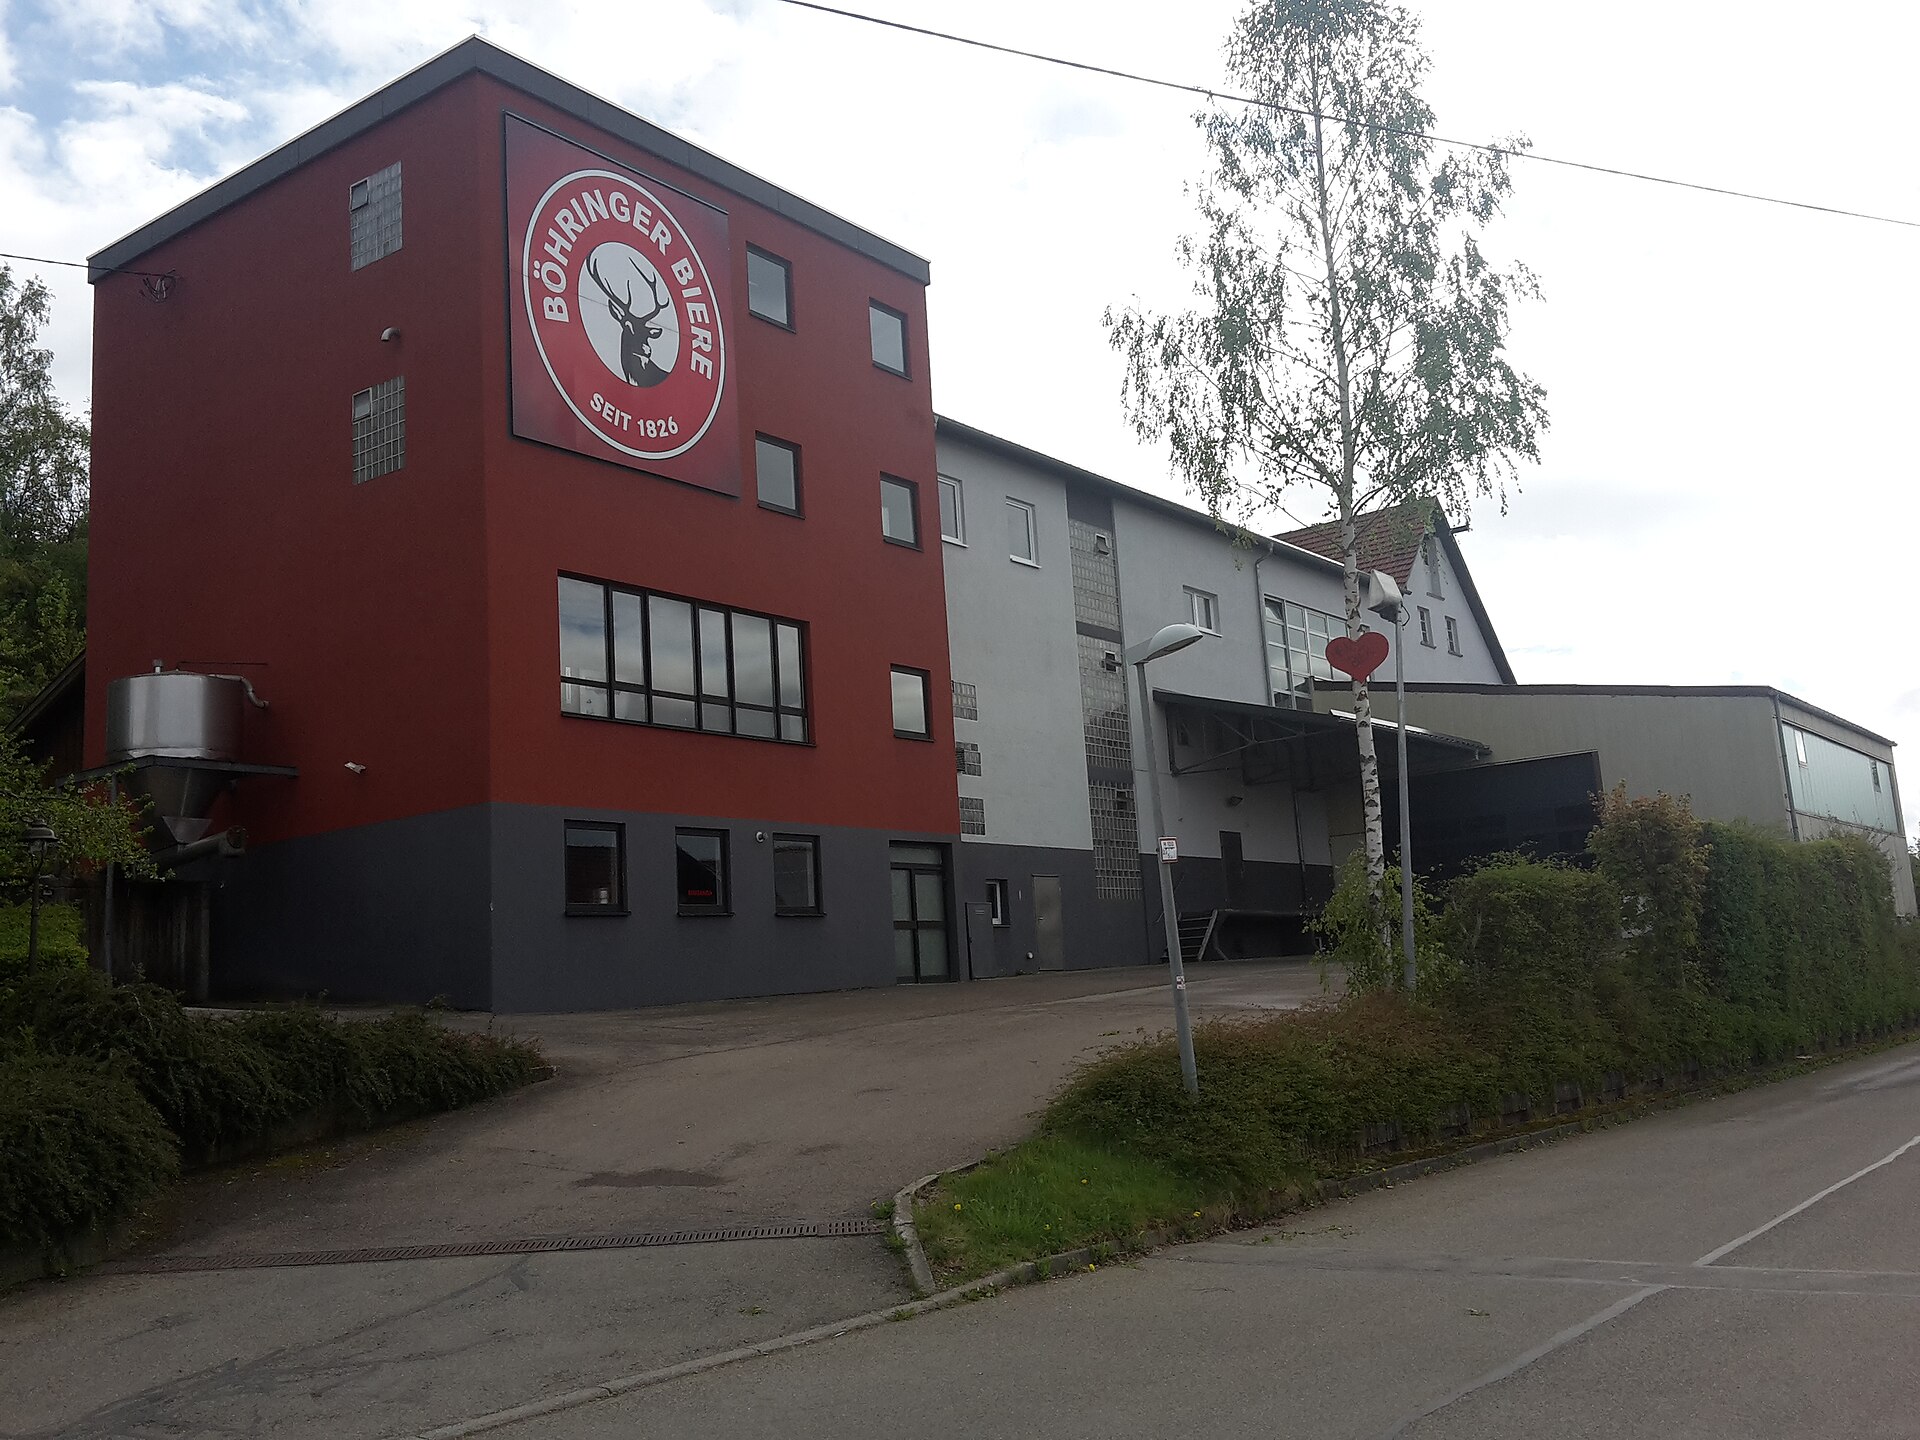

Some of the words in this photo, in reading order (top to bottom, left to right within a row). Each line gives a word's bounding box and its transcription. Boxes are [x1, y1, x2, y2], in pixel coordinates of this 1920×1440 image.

[533, 188, 673, 323] BÖHRINGER
[670, 257, 713, 380] BIERE
[589, 392, 632, 432] SEIT
[636, 415, 679, 439] 1826
